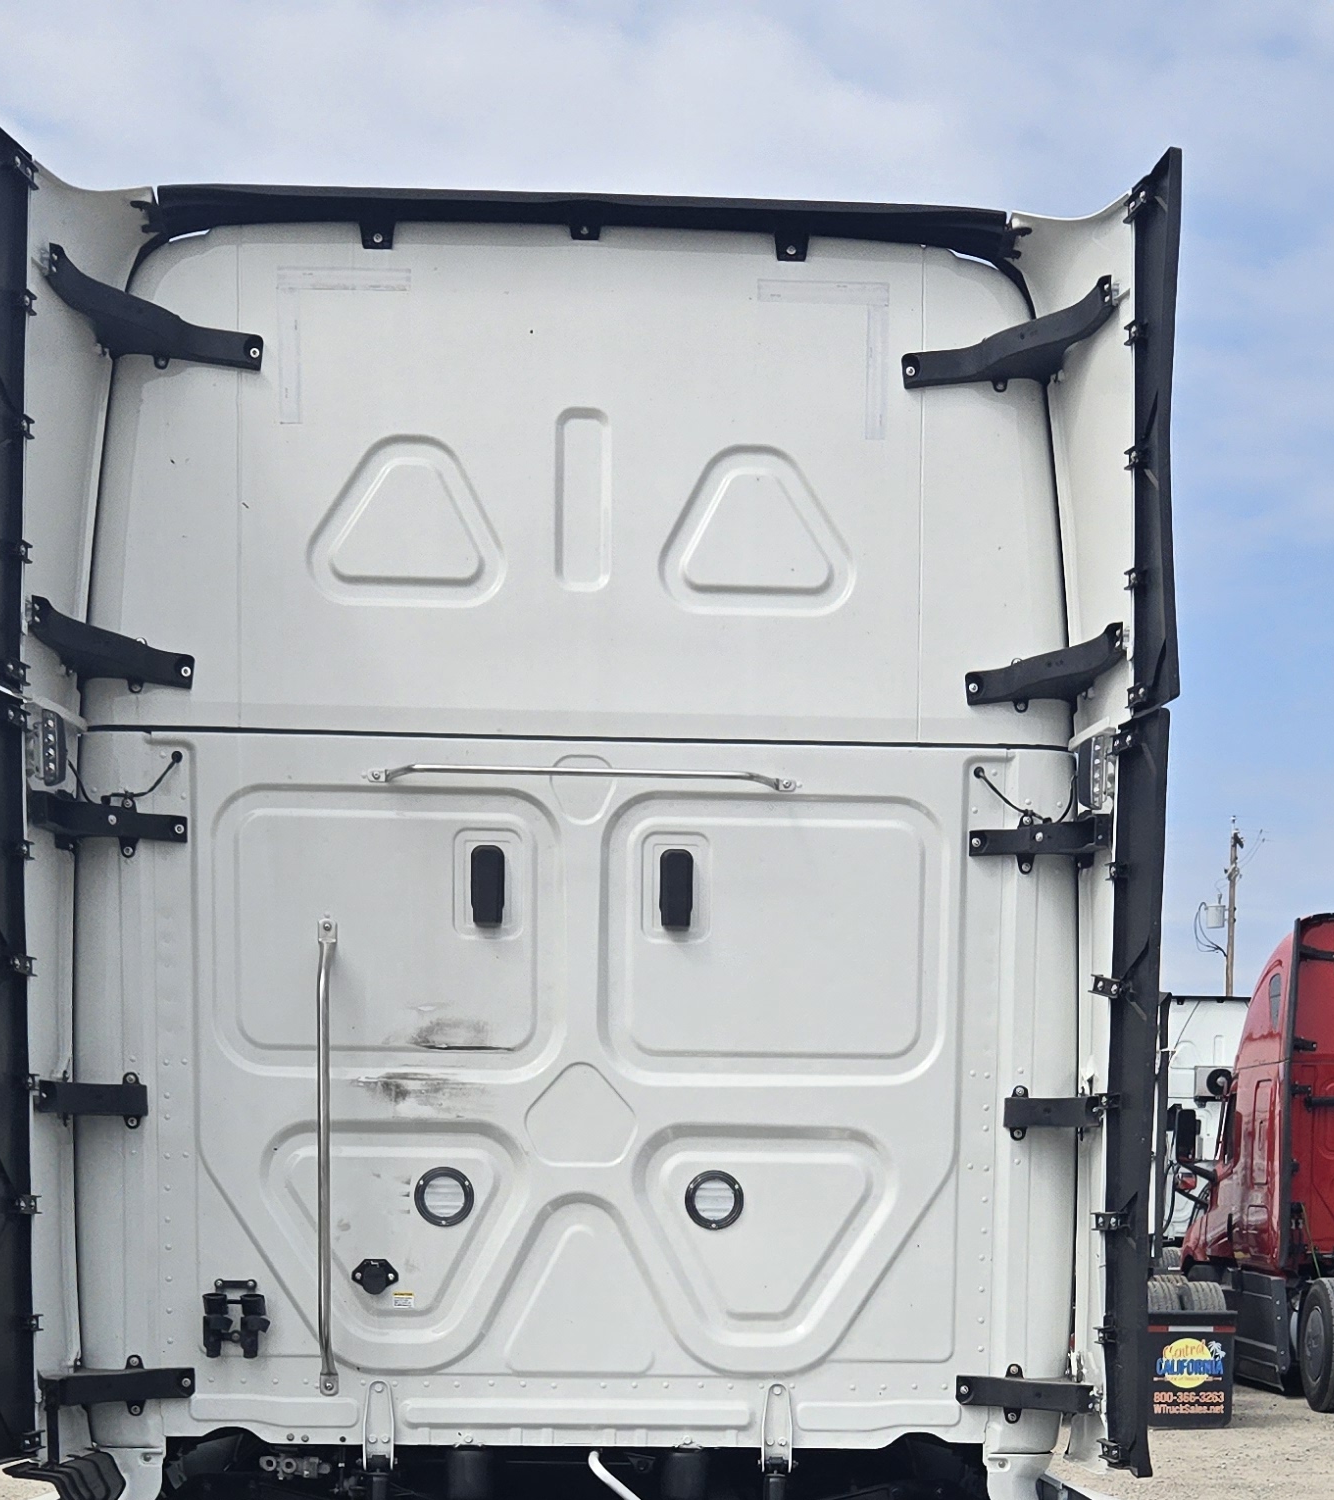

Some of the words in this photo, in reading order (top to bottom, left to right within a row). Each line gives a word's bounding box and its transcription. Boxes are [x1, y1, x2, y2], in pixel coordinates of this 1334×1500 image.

[1162, 1339, 1206, 1359] Central
[1156, 1358, 1223, 1375] CALIFORNIA
[1153, 1391, 1225, 1403] 800-366-3263
[1153, 1403, 1224, 1414] WTruckSales.net
